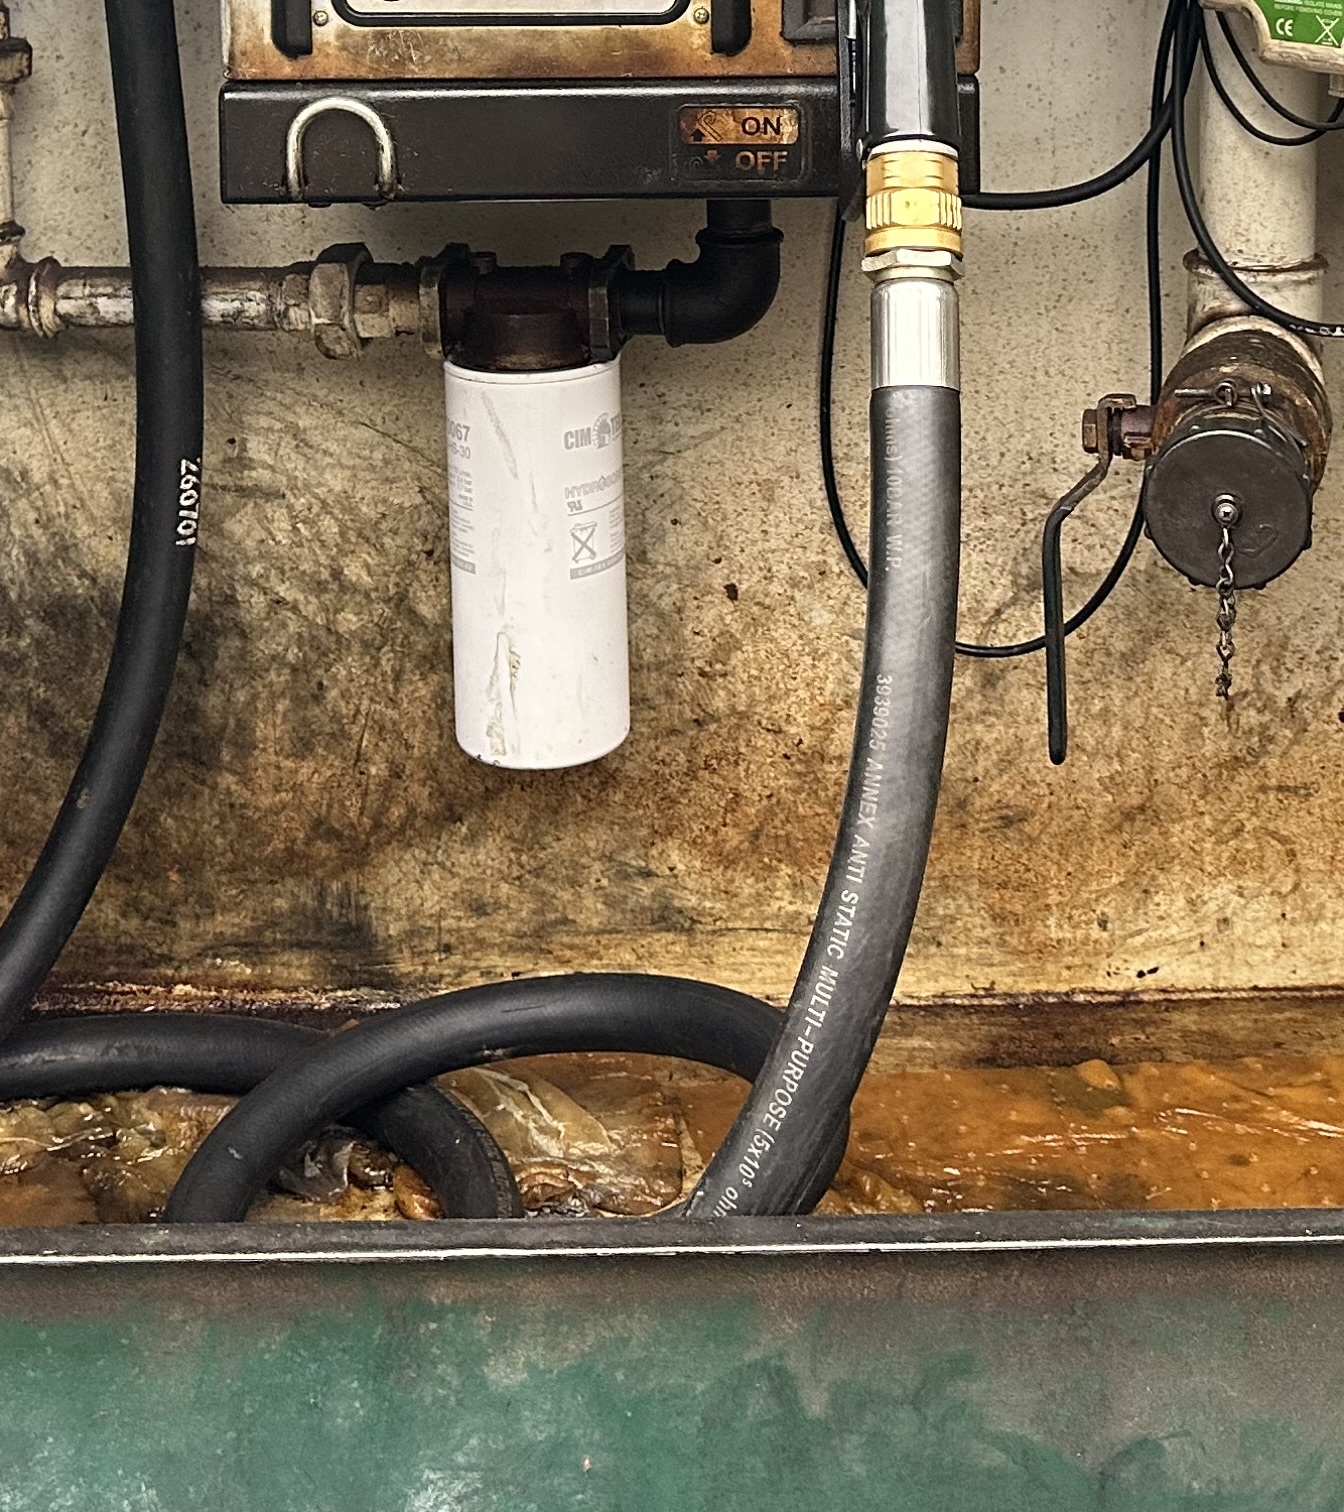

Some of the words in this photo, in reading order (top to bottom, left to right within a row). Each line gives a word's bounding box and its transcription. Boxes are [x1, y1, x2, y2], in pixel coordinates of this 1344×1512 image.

[741, 116, 781, 136] ON
[735, 150, 788, 171] OFF
[564, 427, 591, 450] CIM
[869, 674, 893, 751] 3939025
[857, 758, 883, 829] ANNEX
[846, 834, 871, 884] ANTI
[827, 889, 859, 960] STATIC
[763, 965, 839, 1131] MULTI-PURPOSE
